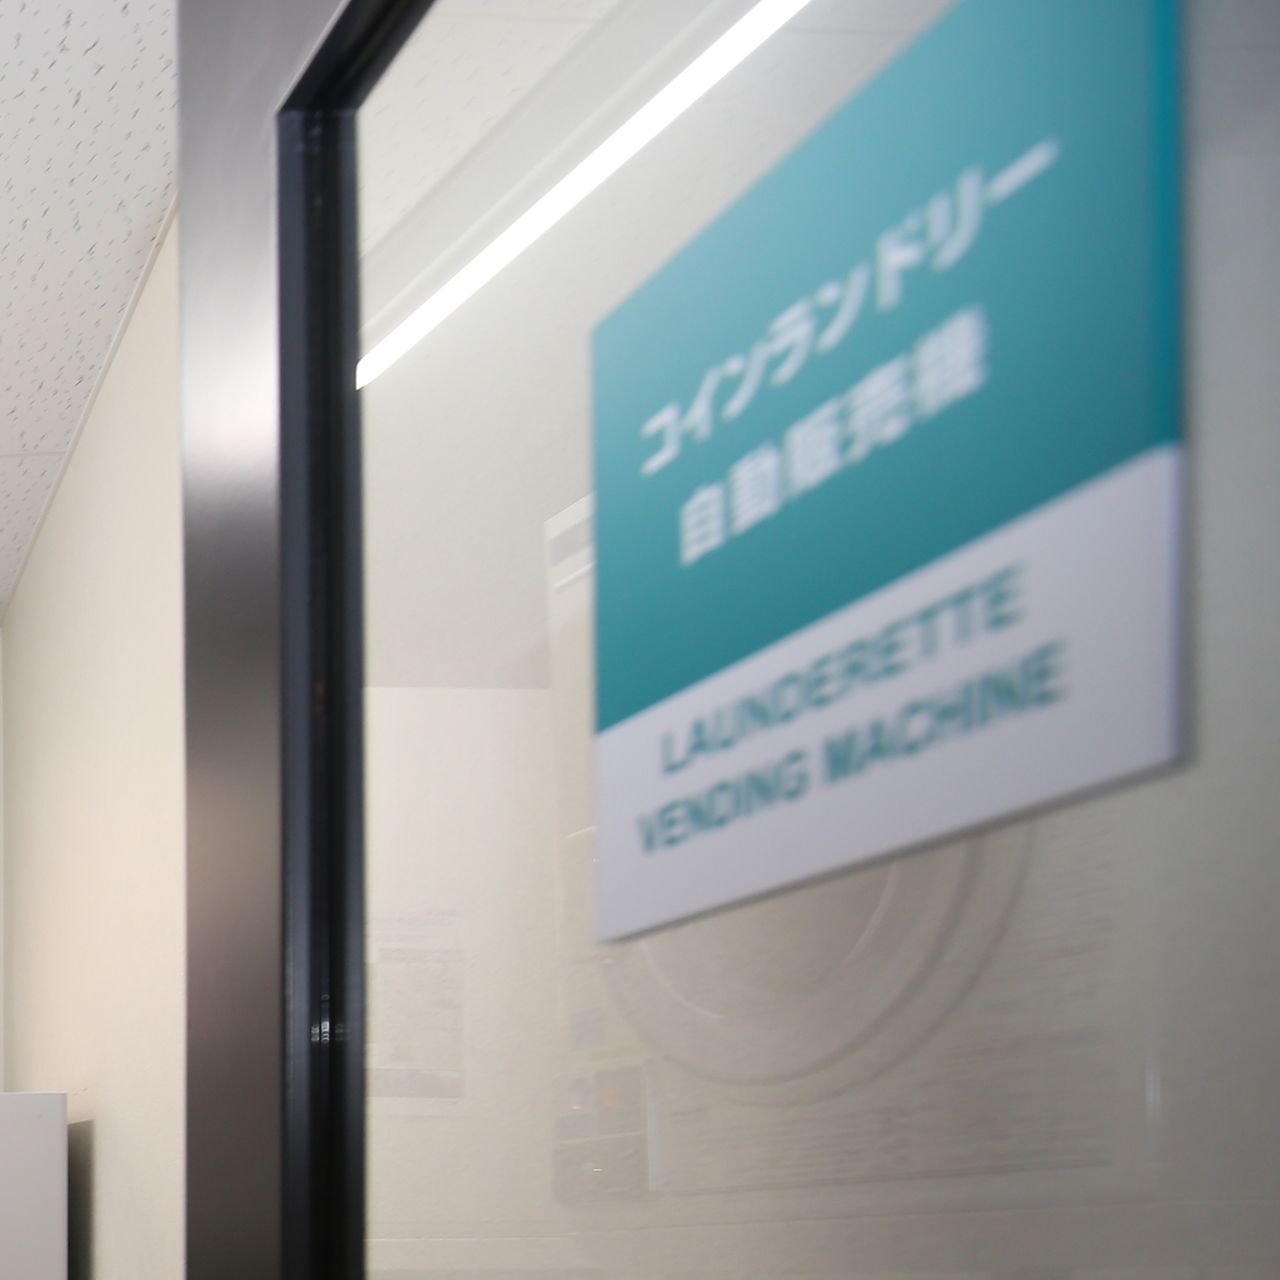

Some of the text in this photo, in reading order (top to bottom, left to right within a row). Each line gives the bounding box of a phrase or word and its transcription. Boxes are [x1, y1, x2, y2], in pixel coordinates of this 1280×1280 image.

[642, 137, 1062, 475] コインランドリー
[680, 305, 988, 567] 自動販売機
[637, 638, 1069, 854] VENDING MACHINE
[659, 562, 1028, 778] LAUNDERETTE
